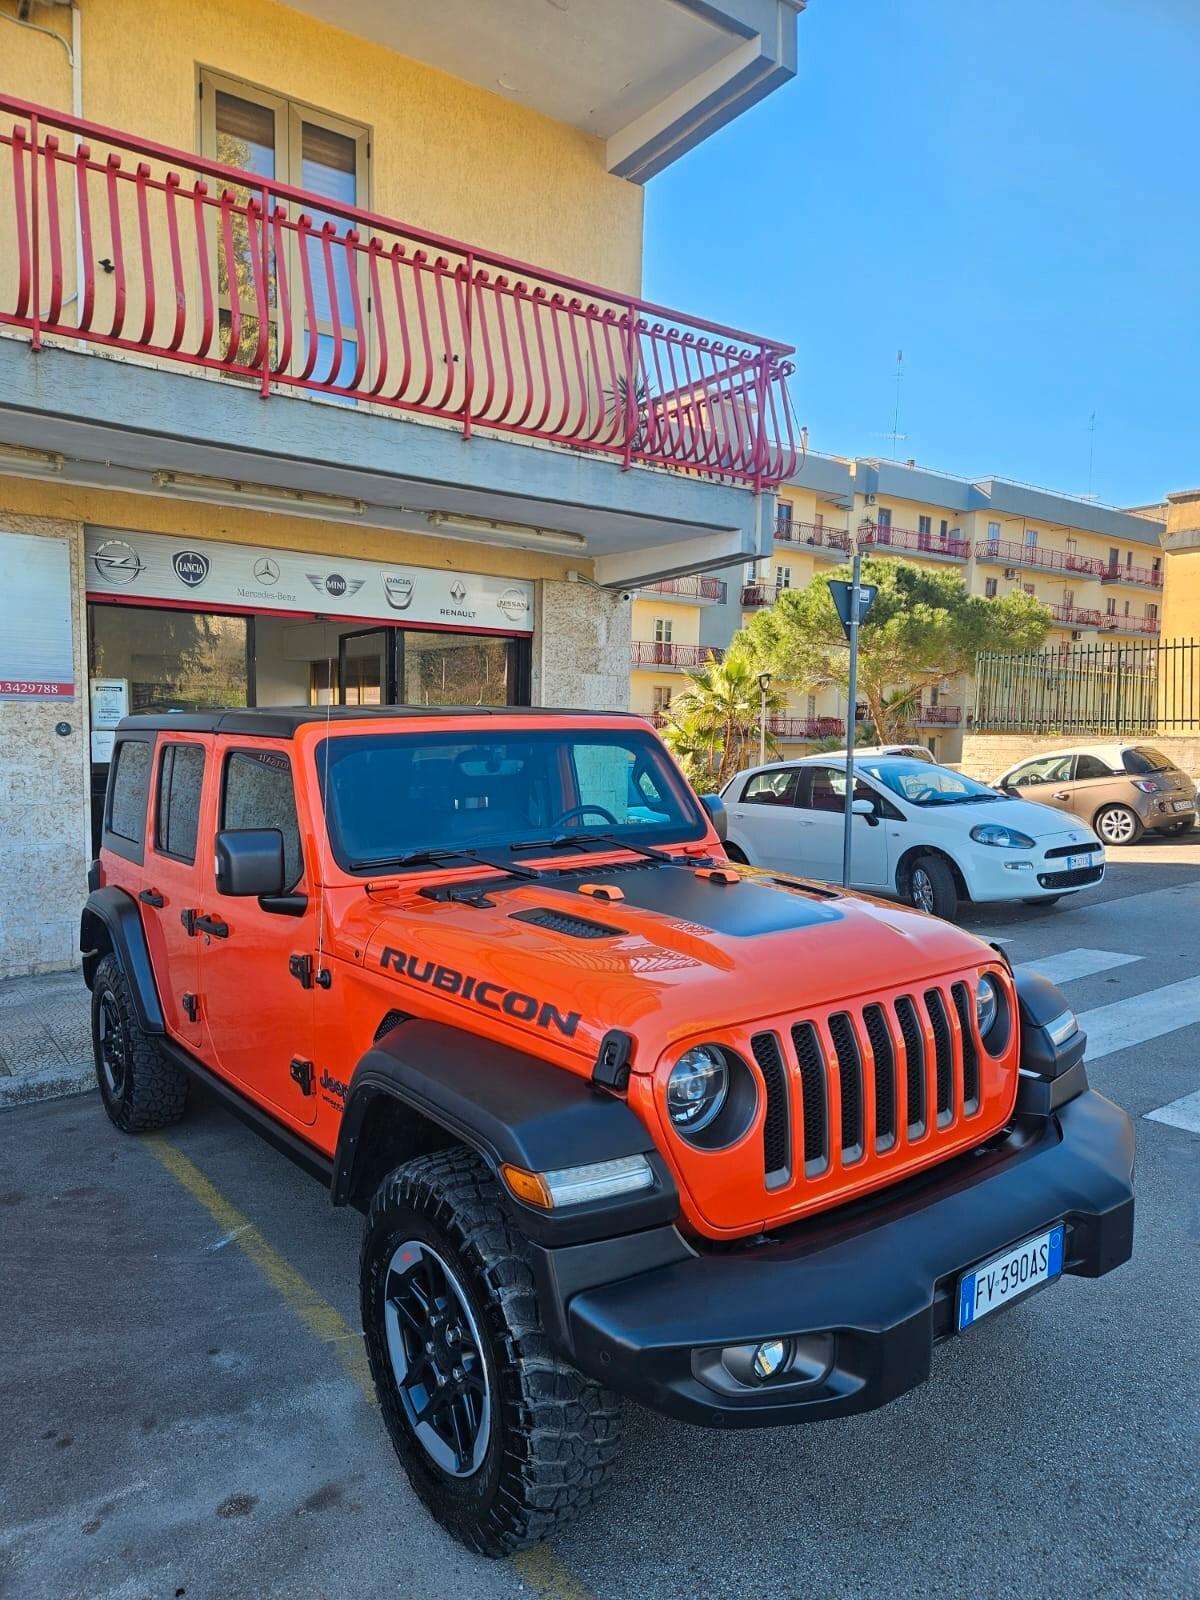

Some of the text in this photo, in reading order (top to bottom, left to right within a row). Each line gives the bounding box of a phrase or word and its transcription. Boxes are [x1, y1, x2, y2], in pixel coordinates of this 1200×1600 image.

[179, 562, 204, 575] LANCIA
[325, 580, 346, 591] MINI
[386, 576, 412, 586] DACIA
[237, 588, 296, 602] Mercedes-Benz
[498, 600, 527, 609] NISSAN
[440, 608, 477, 618] RENAULT
[380, 946, 583, 1039] RUBICON
